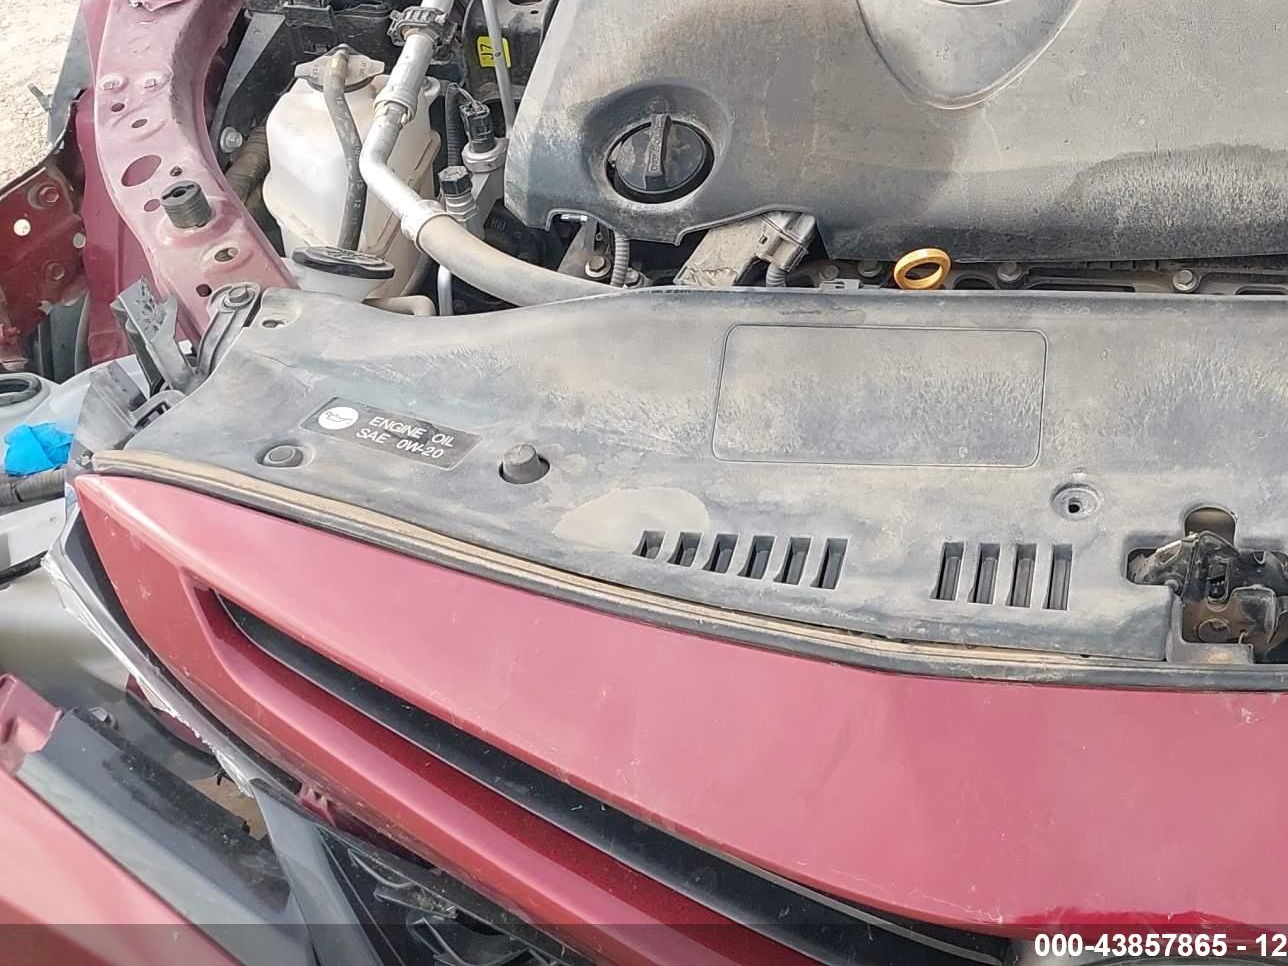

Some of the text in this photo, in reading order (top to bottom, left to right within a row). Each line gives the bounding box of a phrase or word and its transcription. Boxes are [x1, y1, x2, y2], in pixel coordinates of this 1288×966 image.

[356, 428, 444, 459] SAE 0W-20
[369, 416, 455, 448] ENGINE OIL
